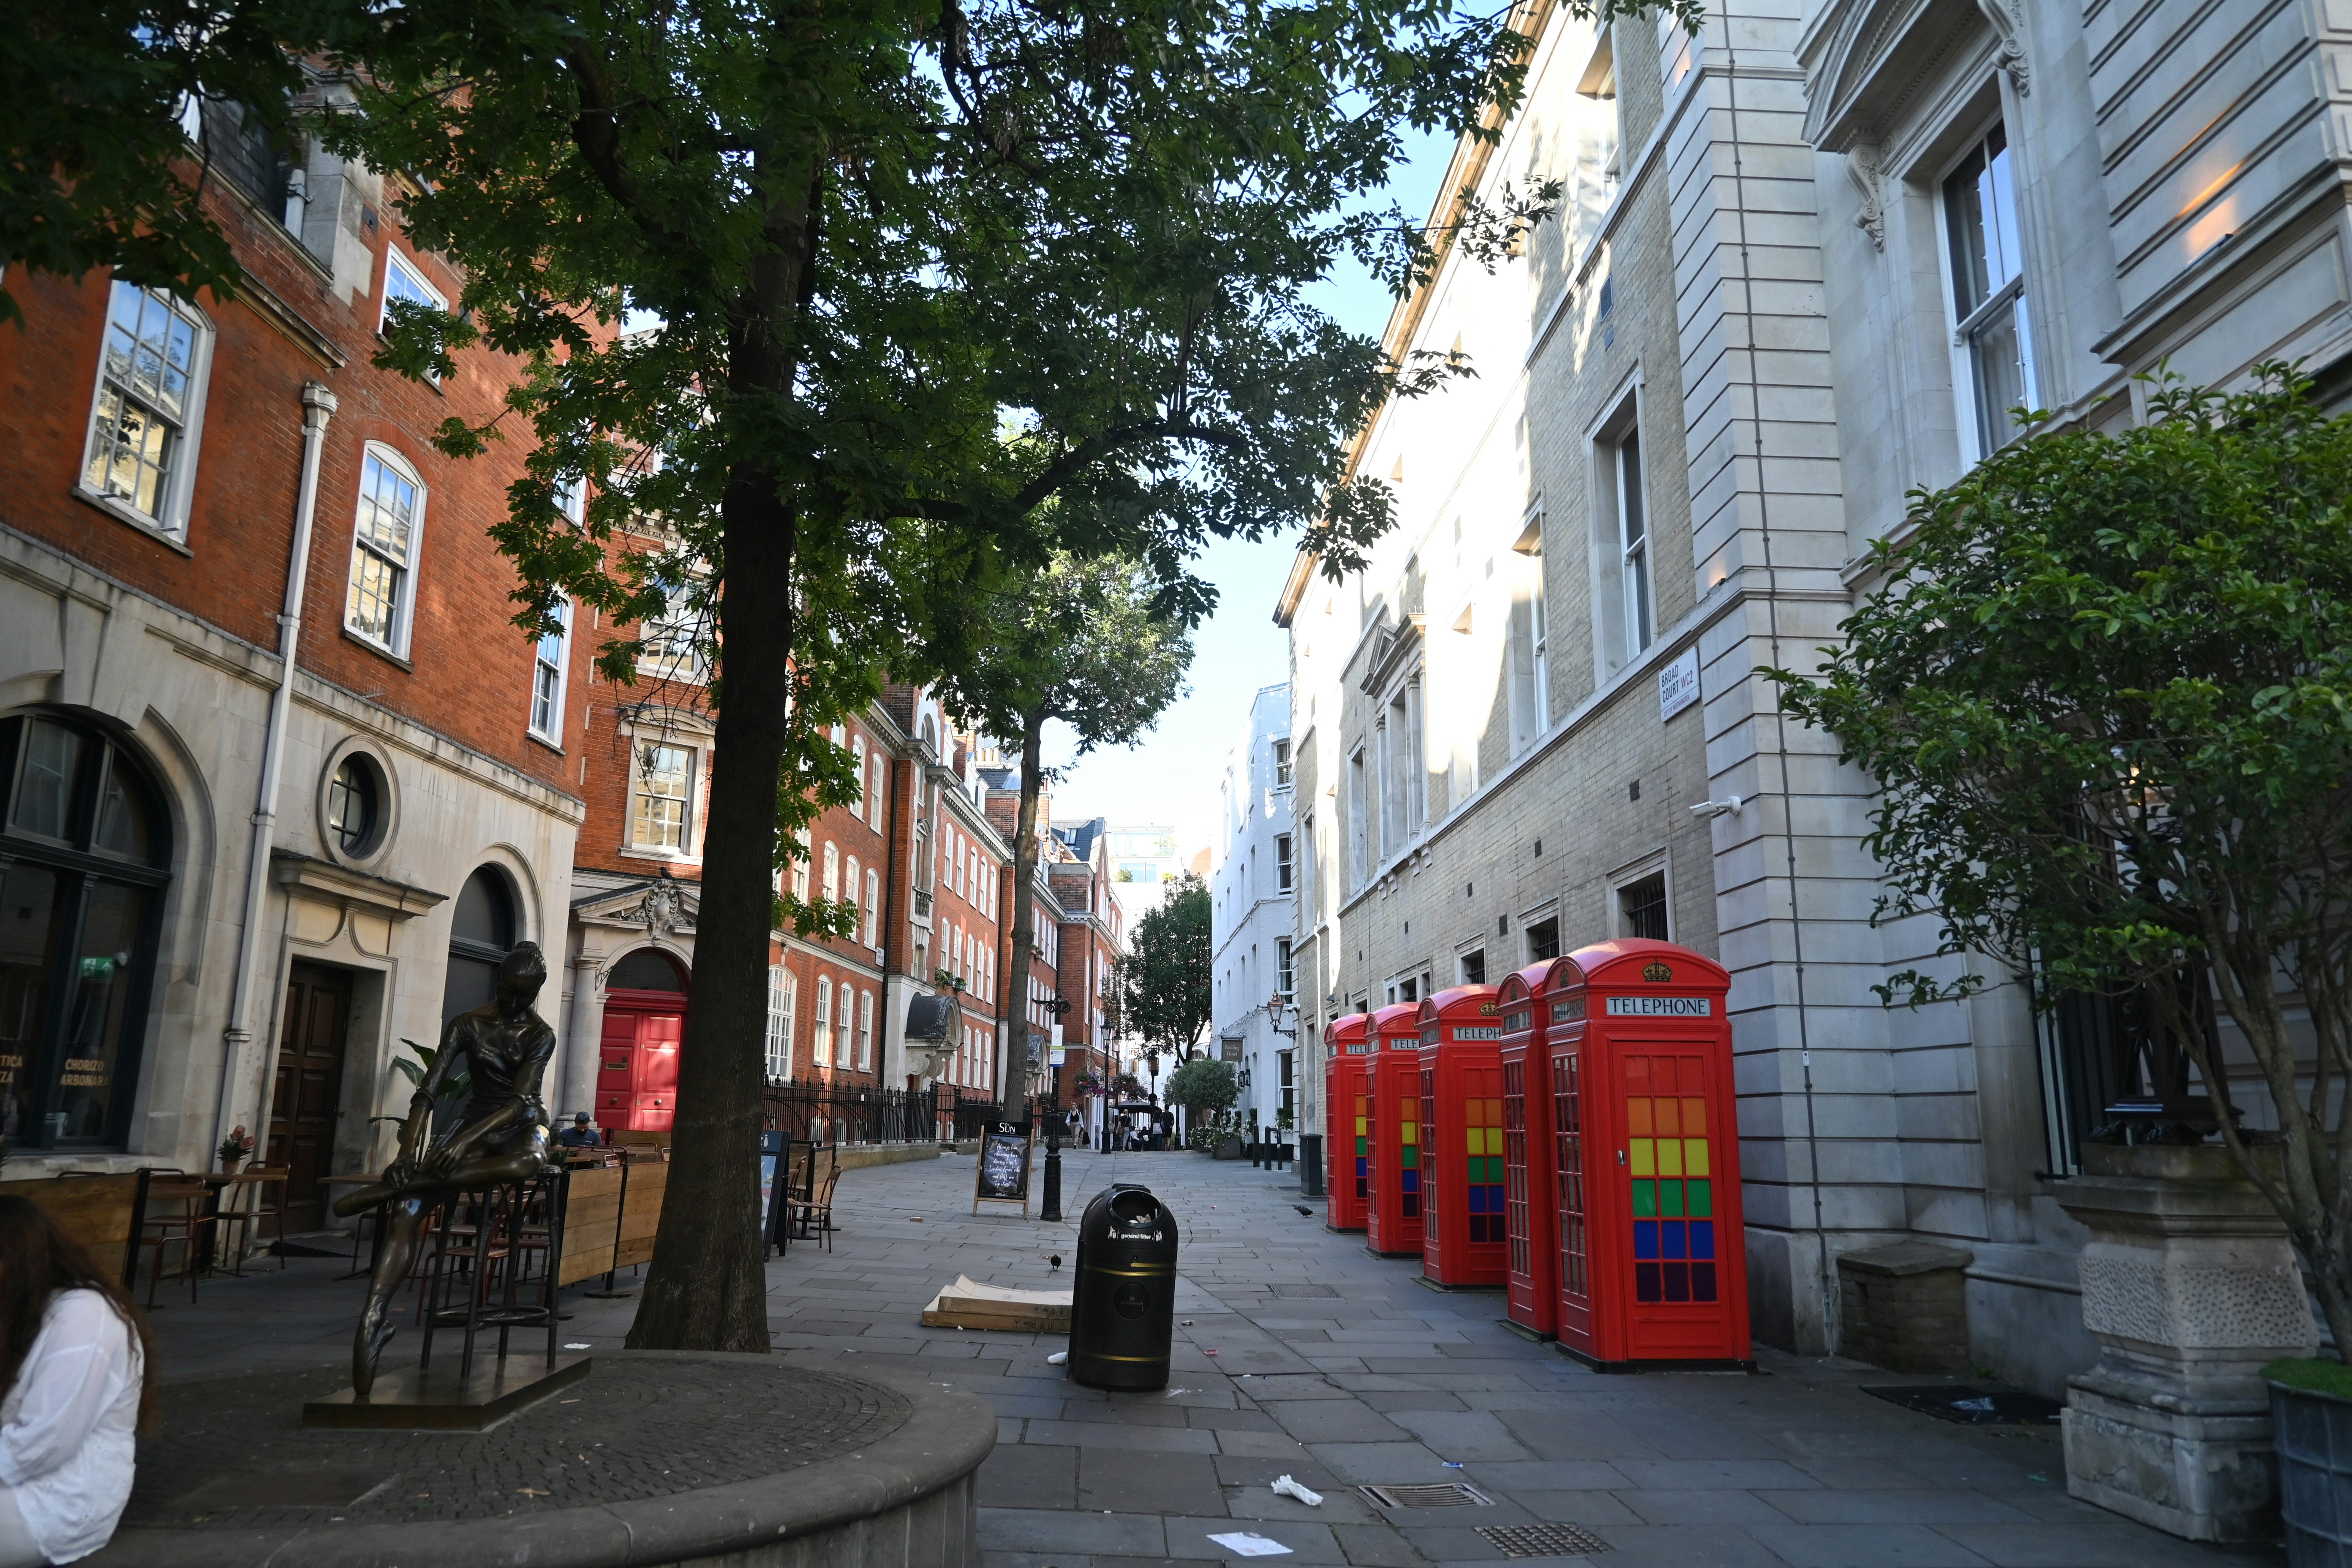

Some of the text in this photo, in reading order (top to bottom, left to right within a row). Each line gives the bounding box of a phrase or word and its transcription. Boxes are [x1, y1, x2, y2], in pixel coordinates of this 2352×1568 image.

[1661, 664, 1678, 688] BROAD
[1662, 670, 1693, 703] COURT WC2
[1673, 694, 1690, 710] WESTMINSTER
[343, 929, 348, 941] 5
[1609, 998, 1707, 1014] TELEPHONE
[1456, 1028, 1500, 1039] TELEPH
[1393, 1040, 1421, 1048] TELE
[0, 1055, 23, 1068] TICA
[65, 1059, 104, 1071] CHORIZO
[0, 1071, 14, 1083] ZA
[60, 1074, 109, 1086] ARBONARA
[999, 1122, 1015, 1134] SUN
